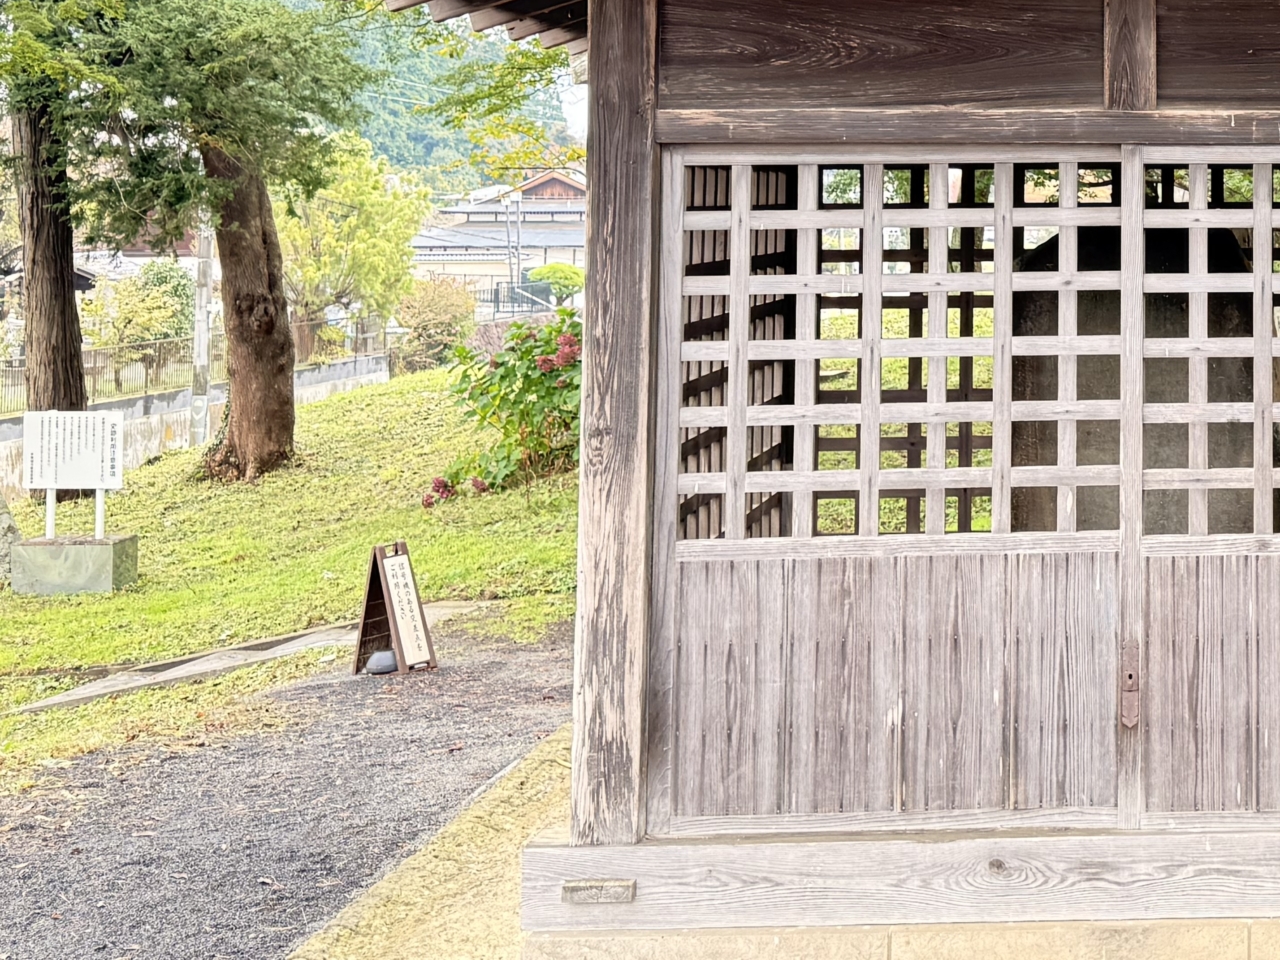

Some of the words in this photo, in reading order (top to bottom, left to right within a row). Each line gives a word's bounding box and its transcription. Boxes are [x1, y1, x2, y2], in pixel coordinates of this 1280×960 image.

[391, 563, 407, 620] ご利用ください
[398, 562, 423, 652] 信号機のある交差点を
